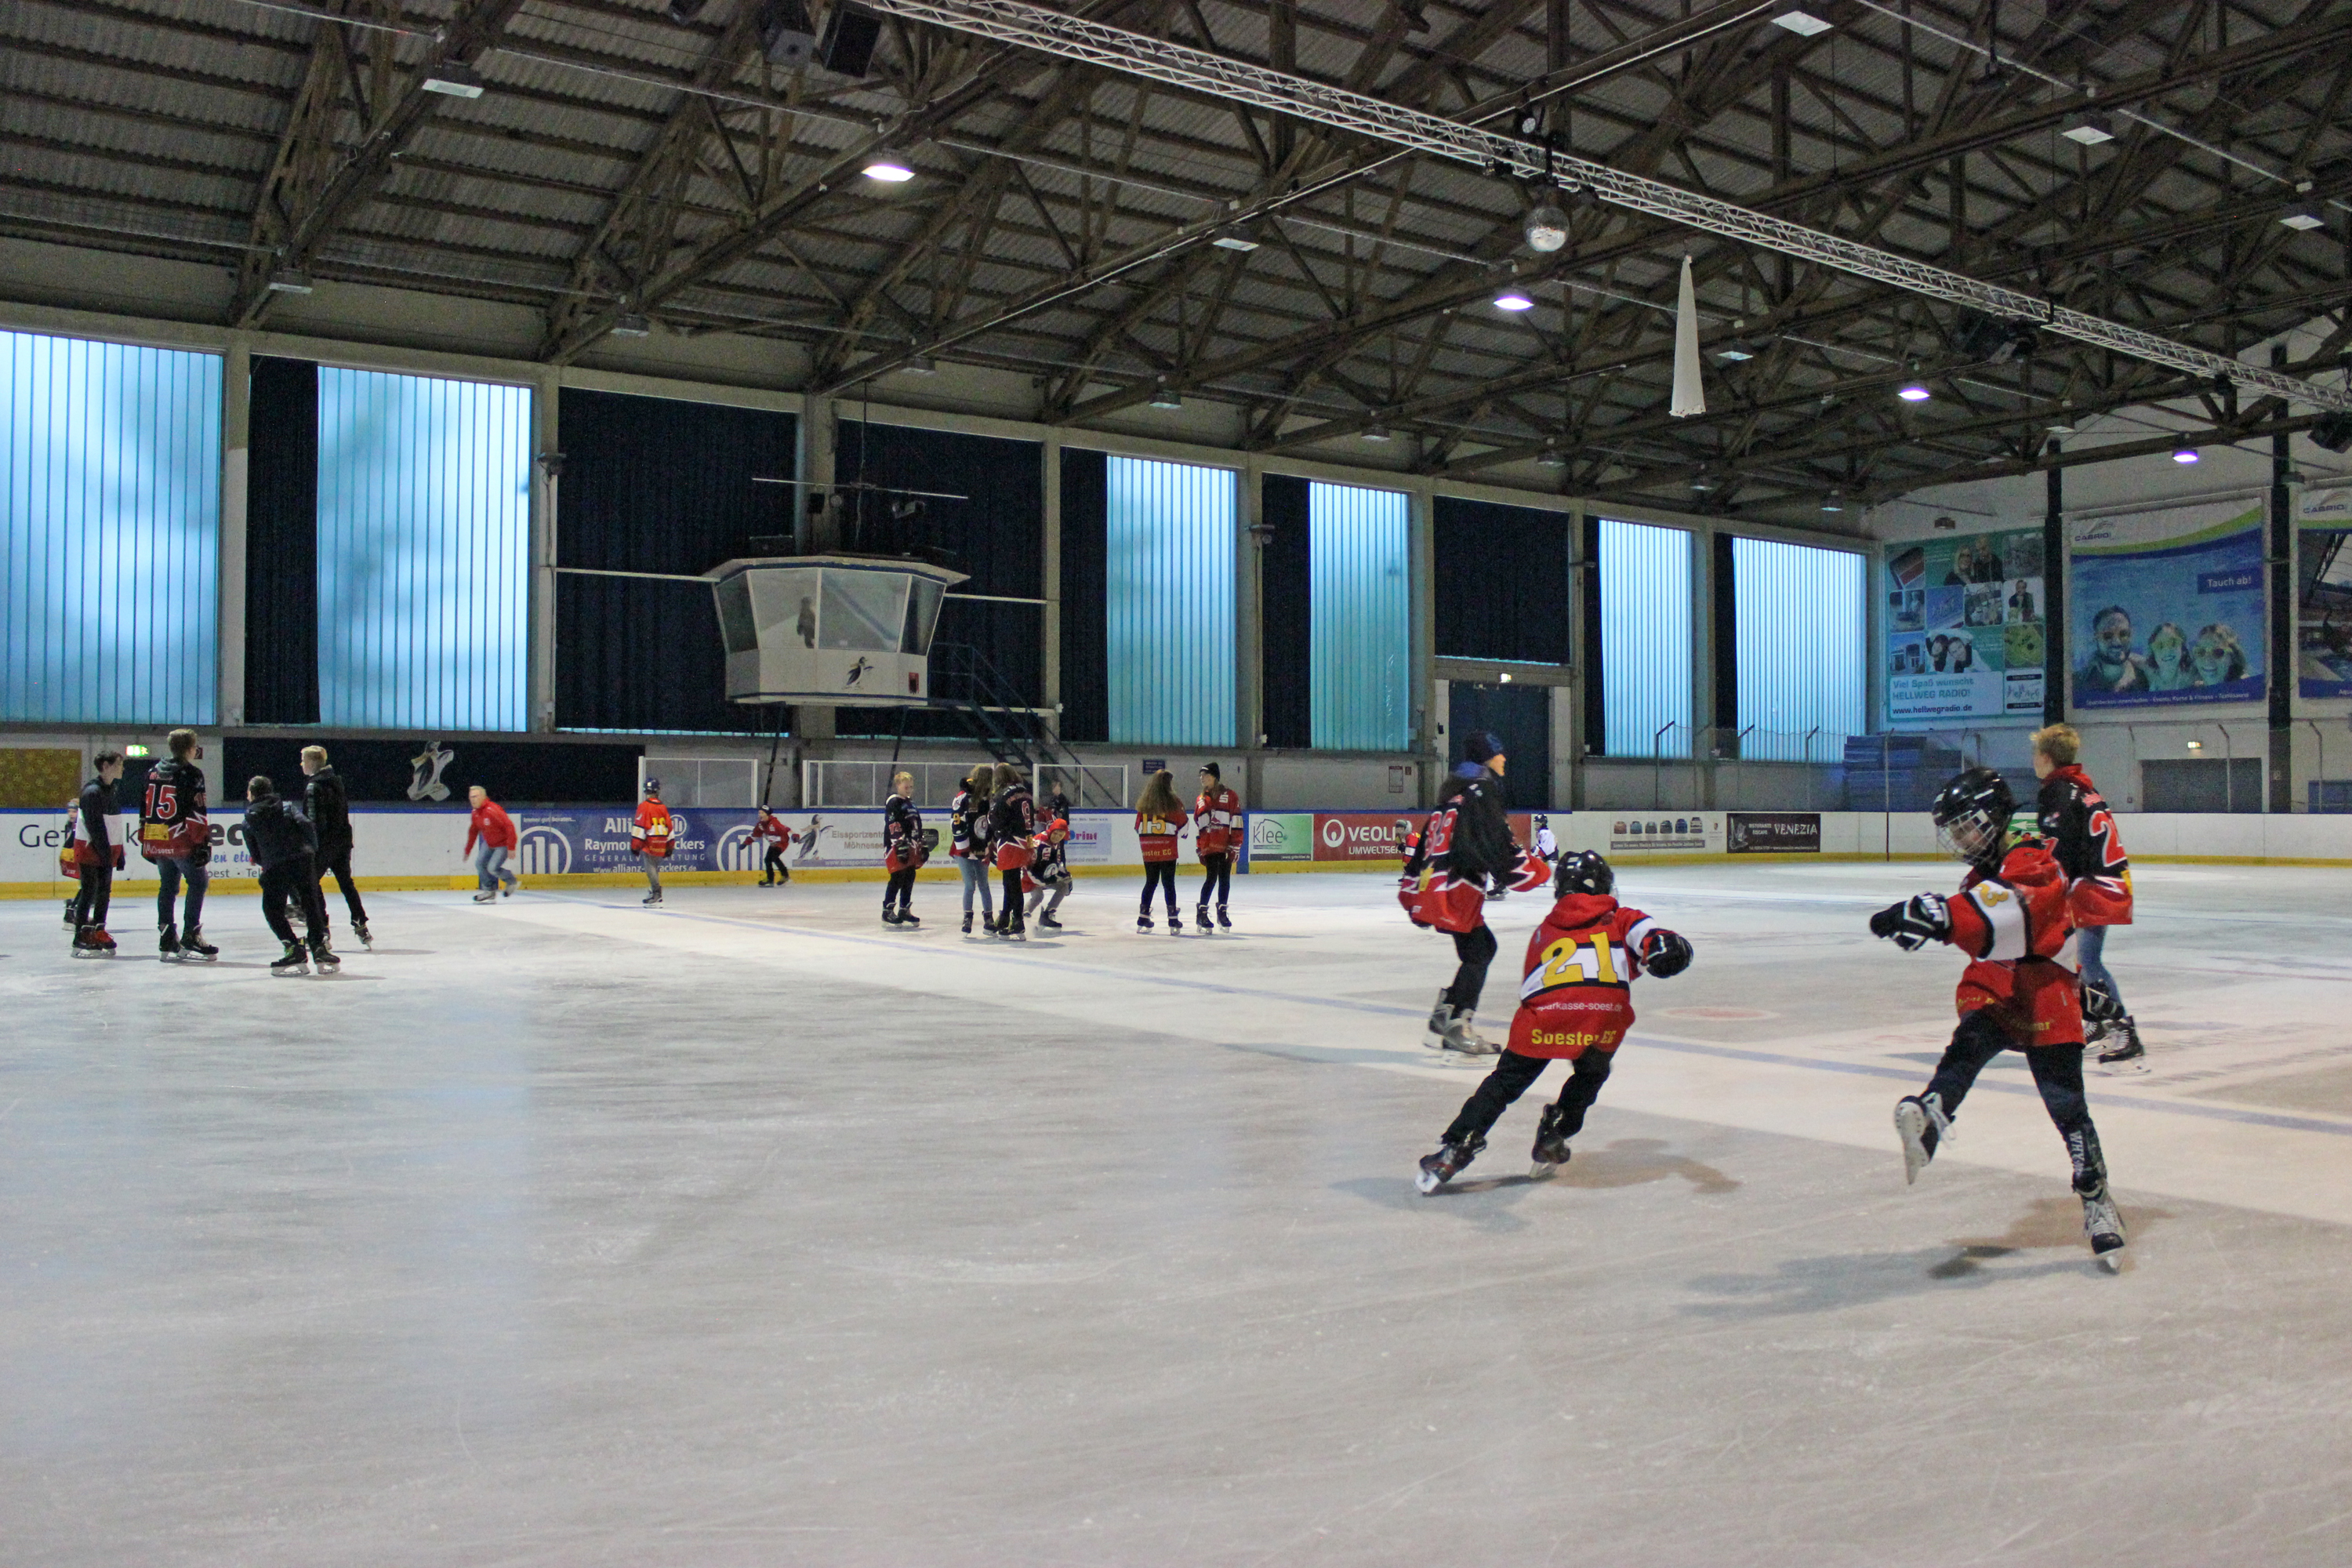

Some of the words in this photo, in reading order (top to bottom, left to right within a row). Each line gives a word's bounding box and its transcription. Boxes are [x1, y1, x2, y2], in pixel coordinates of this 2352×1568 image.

[2207, 578, 2234, 588] Tauch
[2237, 575, 2252, 585] ab!
[1911, 679, 1933, 689] Spaß
[1892, 690, 1936, 699] HELLWEG
[145, 783, 177, 819] 15
[604, 818, 633, 833] Alli
[953, 813, 960, 825] 9
[1142, 813, 1167, 835] 15
[832, 830, 884, 840] Eissportzentr
[1253, 826, 1283, 844] klee
[1348, 826, 1396, 842] VEOLI
[1773, 823, 1818, 835] VENEZIA
[585, 838, 631, 854] Raymo
[208, 869, 230, 877] oest
[1541, 931, 1618, 989] 21
